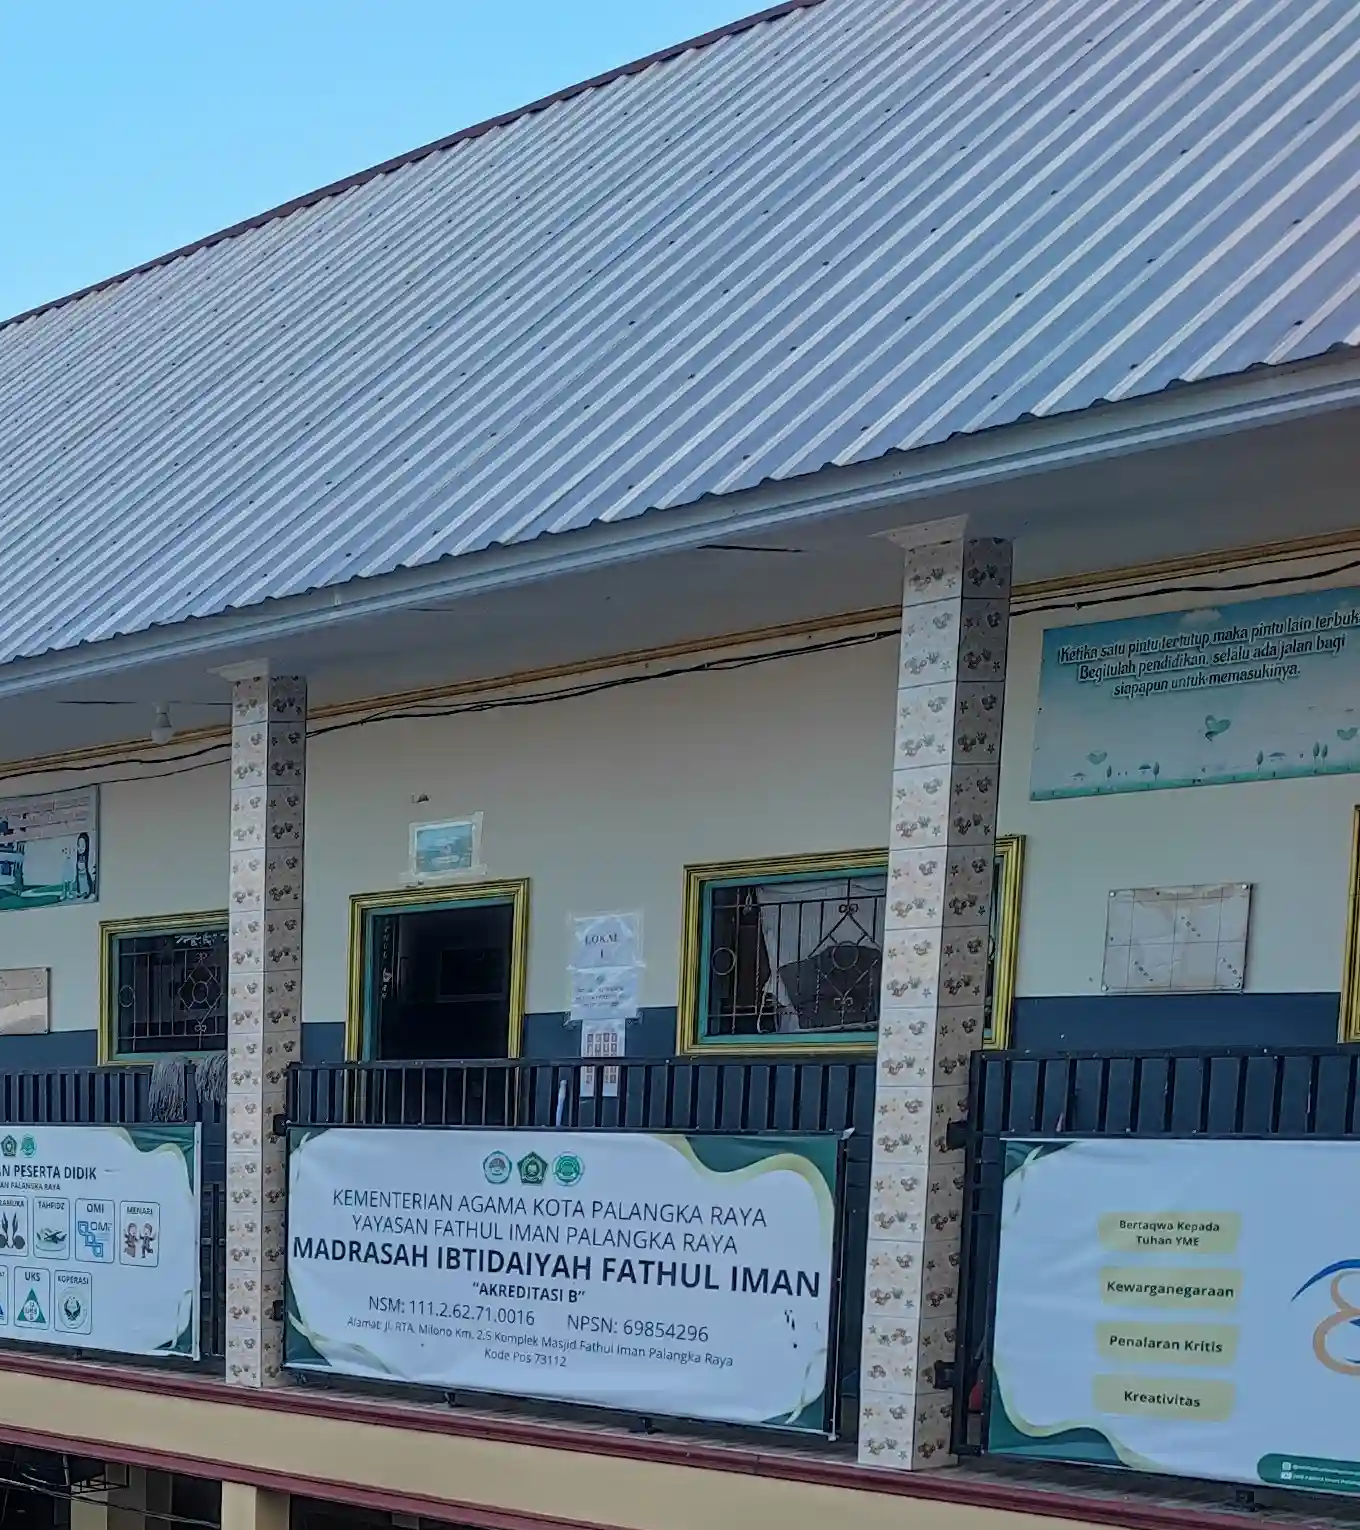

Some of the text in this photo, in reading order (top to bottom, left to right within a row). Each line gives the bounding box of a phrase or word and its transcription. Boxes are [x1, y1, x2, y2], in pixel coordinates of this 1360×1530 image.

[1100, 644, 1126, 658] satu
[1127, 639, 1159, 658] pintu
[1161, 632, 1210, 650] tertutup
[1212, 625, 1248, 642] maka
[1251, 621, 1284, 641] pintu
[1287, 617, 1312, 633] lain
[1315, 609, 1360, 630] terbuk
[1079, 660, 1136, 682] Begitulah
[1212, 645, 1250, 664] selalu
[1252, 641, 1277, 657] ada
[1279, 638, 1313, 660] jalan
[1316, 633, 1347, 653] bagi
[1113, 679, 1168, 698] siapapun
[1171, 671, 1205, 689] untuk
[14, 1164, 61, 1179] PESERTA
[64, 1166, 97, 1180] DIDIK
[86, 1203, 104, 1214] OMI
[333, 1189, 767, 1228] KEMENTERIAN AGAMA KOTA PALANGKA RAYA
[352, 1214, 738, 1255] YAYASAN FATHUL IMAN PALANGKA RAYA
[1119, 1219, 1221, 1236] Bertaqwa Kepada
[1137, 1234, 1200, 1247] Tuhan YME
[24, 1271, 41, 1282] UKS
[293, 1236, 820, 1298] MADRASAH IBTIDAIYAH FATHUL IMAN
[57, 1275, 89, 1285] KOPERASI
[1106, 1279, 1235, 1299] Kewarganegaraan
[369, 1295, 536, 1326] NSM: 111.2.62.71.0016
[567, 1314, 709, 1343] NPSN: 69854296
[418, 1324, 453, 1338] Milono
[494, 1330, 538, 1347] Komplek
[541, 1335, 577, 1352] Masjid
[579, 1340, 614, 1354] Fathul
[616, 1344, 646, 1357] Iman
[648, 1347, 701, 1365] Palangka
[704, 1352, 734, 1370] Raya
[1109, 1334, 1223, 1354] Penalaran Kritis
[484, 1348, 567, 1368] Kode Pos 73112
[1124, 1389, 1201, 1409] Kreativitas
